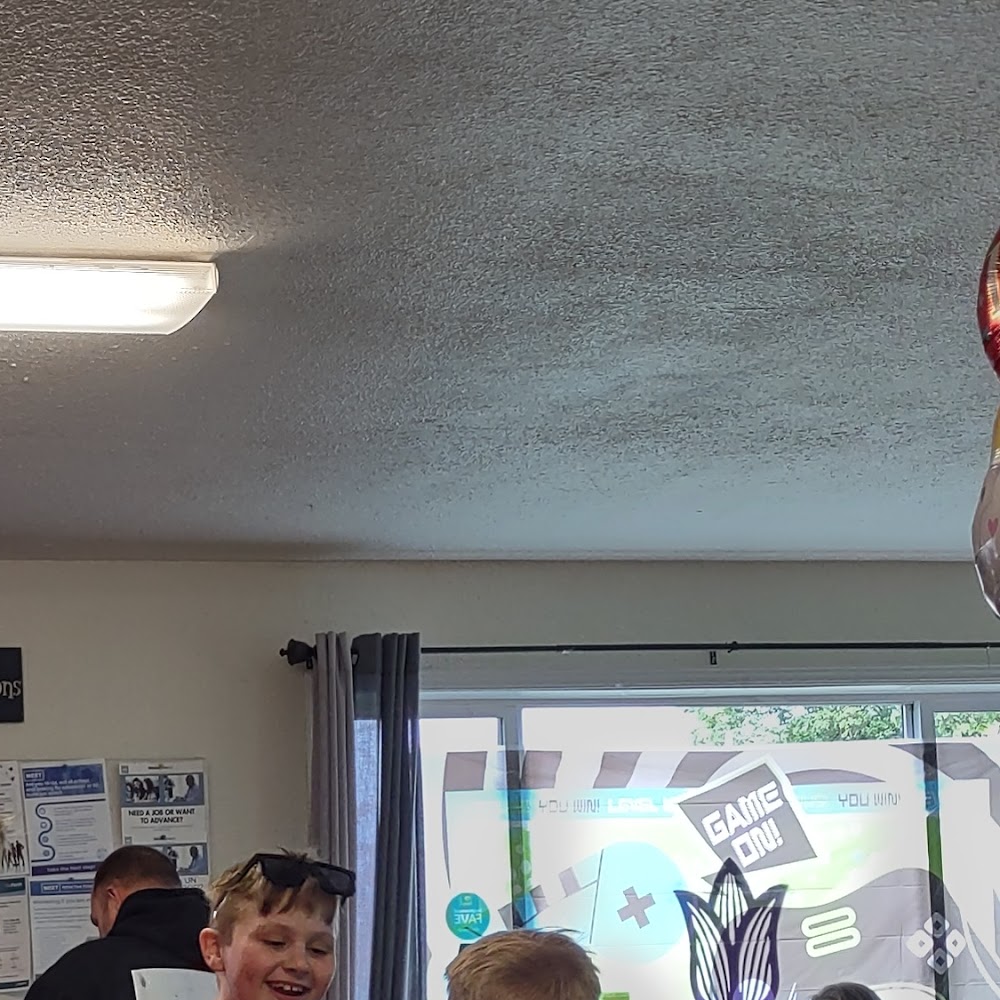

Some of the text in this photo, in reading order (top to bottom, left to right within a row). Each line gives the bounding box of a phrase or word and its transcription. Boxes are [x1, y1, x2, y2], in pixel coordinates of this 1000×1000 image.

[538, 799, 569, 813] YOU
[573, 798, 600, 813] WIN!
[838, 793, 869, 807] YOU
[150, 816, 183, 824] ADVANCE?
[702, 780, 784, 847] GAME
[731, 818, 784, 868] ON!
